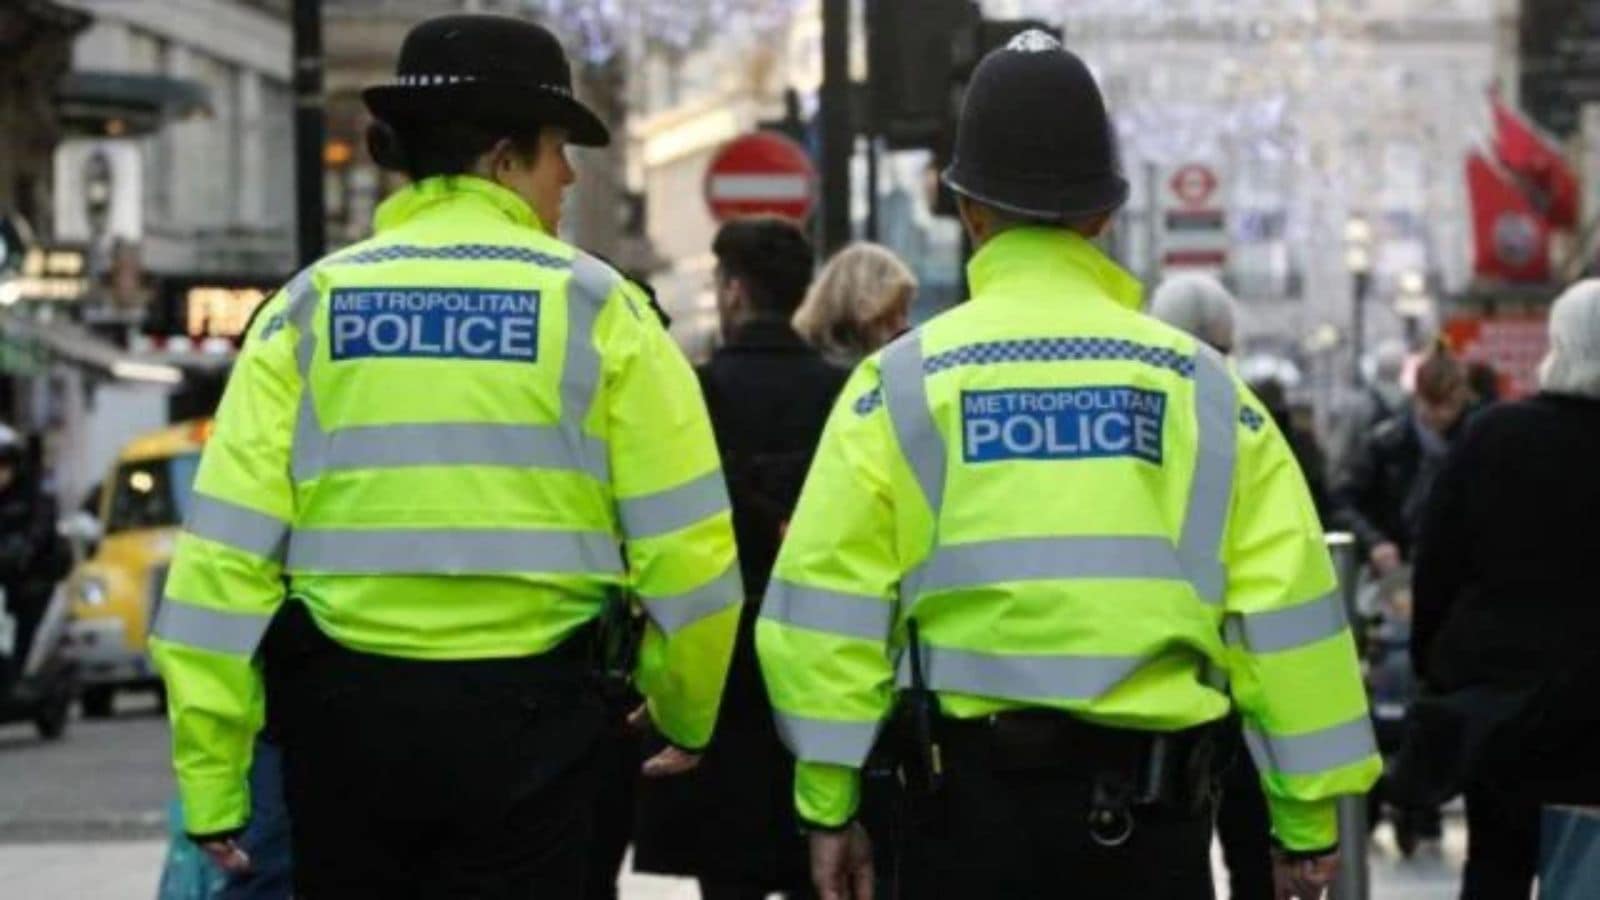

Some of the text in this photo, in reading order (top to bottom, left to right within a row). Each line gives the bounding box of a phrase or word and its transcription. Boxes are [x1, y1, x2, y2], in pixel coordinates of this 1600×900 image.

[334, 291, 535, 313] METROPOLITAN
[334, 314, 534, 356] POLICE
[965, 390, 1161, 415] METROPOLITAN
[966, 412, 1160, 458] POLICE
